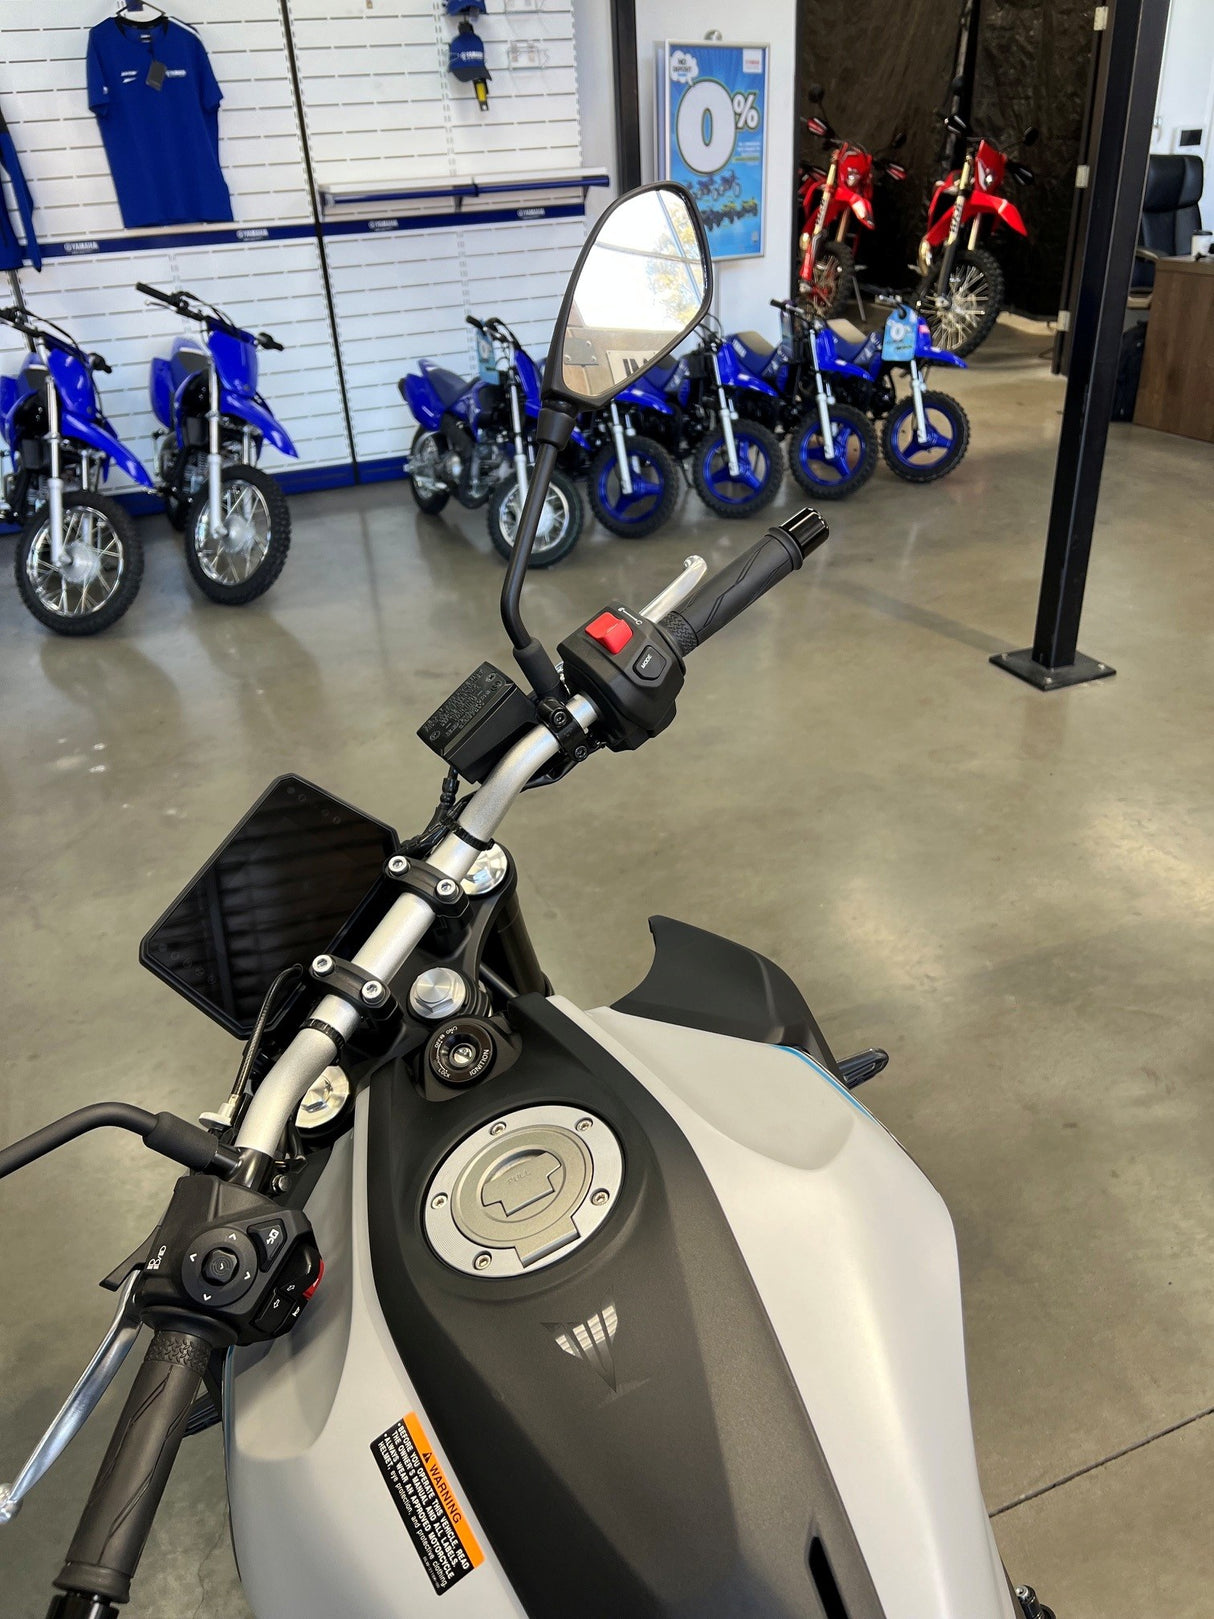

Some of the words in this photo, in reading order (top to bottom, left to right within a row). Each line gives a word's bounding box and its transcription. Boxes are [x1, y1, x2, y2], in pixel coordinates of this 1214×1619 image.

[640, 654, 653, 669] MODE
[438, 1068, 451, 1078] LOCK
[469, 1049, 490, 1077] IGNITION
[377, 1440, 394, 1471] HELMET,
[390, 1470, 399, 1483] eye
[391, 1429, 402, 1446] THE
[397, 1444, 416, 1477] OWNER'S
[412, 1475, 429, 1506] MANUAL
[425, 1505, 437, 1522] AND
[433, 1522, 444, 1538] ALL
[384, 1436, 400, 1463] ALWAYS
[396, 1461, 409, 1484] WEAR
[404, 1483, 415, 1495] AN
[410, 1495, 432, 1532] APPROVED
[428, 1531, 455, 1580] MOTORCYCLE
[394, 1482, 413, 1516] protection,
[398, 1425, 414, 1453] BEFORE
[410, 1451, 421, 1468] YOU
[416, 1467, 436, 1500] OPERATE
[432, 1498, 444, 1517] THIS
[455, 1548, 470, 1570] READ
[429, 1464, 462, 1524] WARNING
[410, 1515, 421, 1529] and
[415, 1528, 435, 1560] protective
